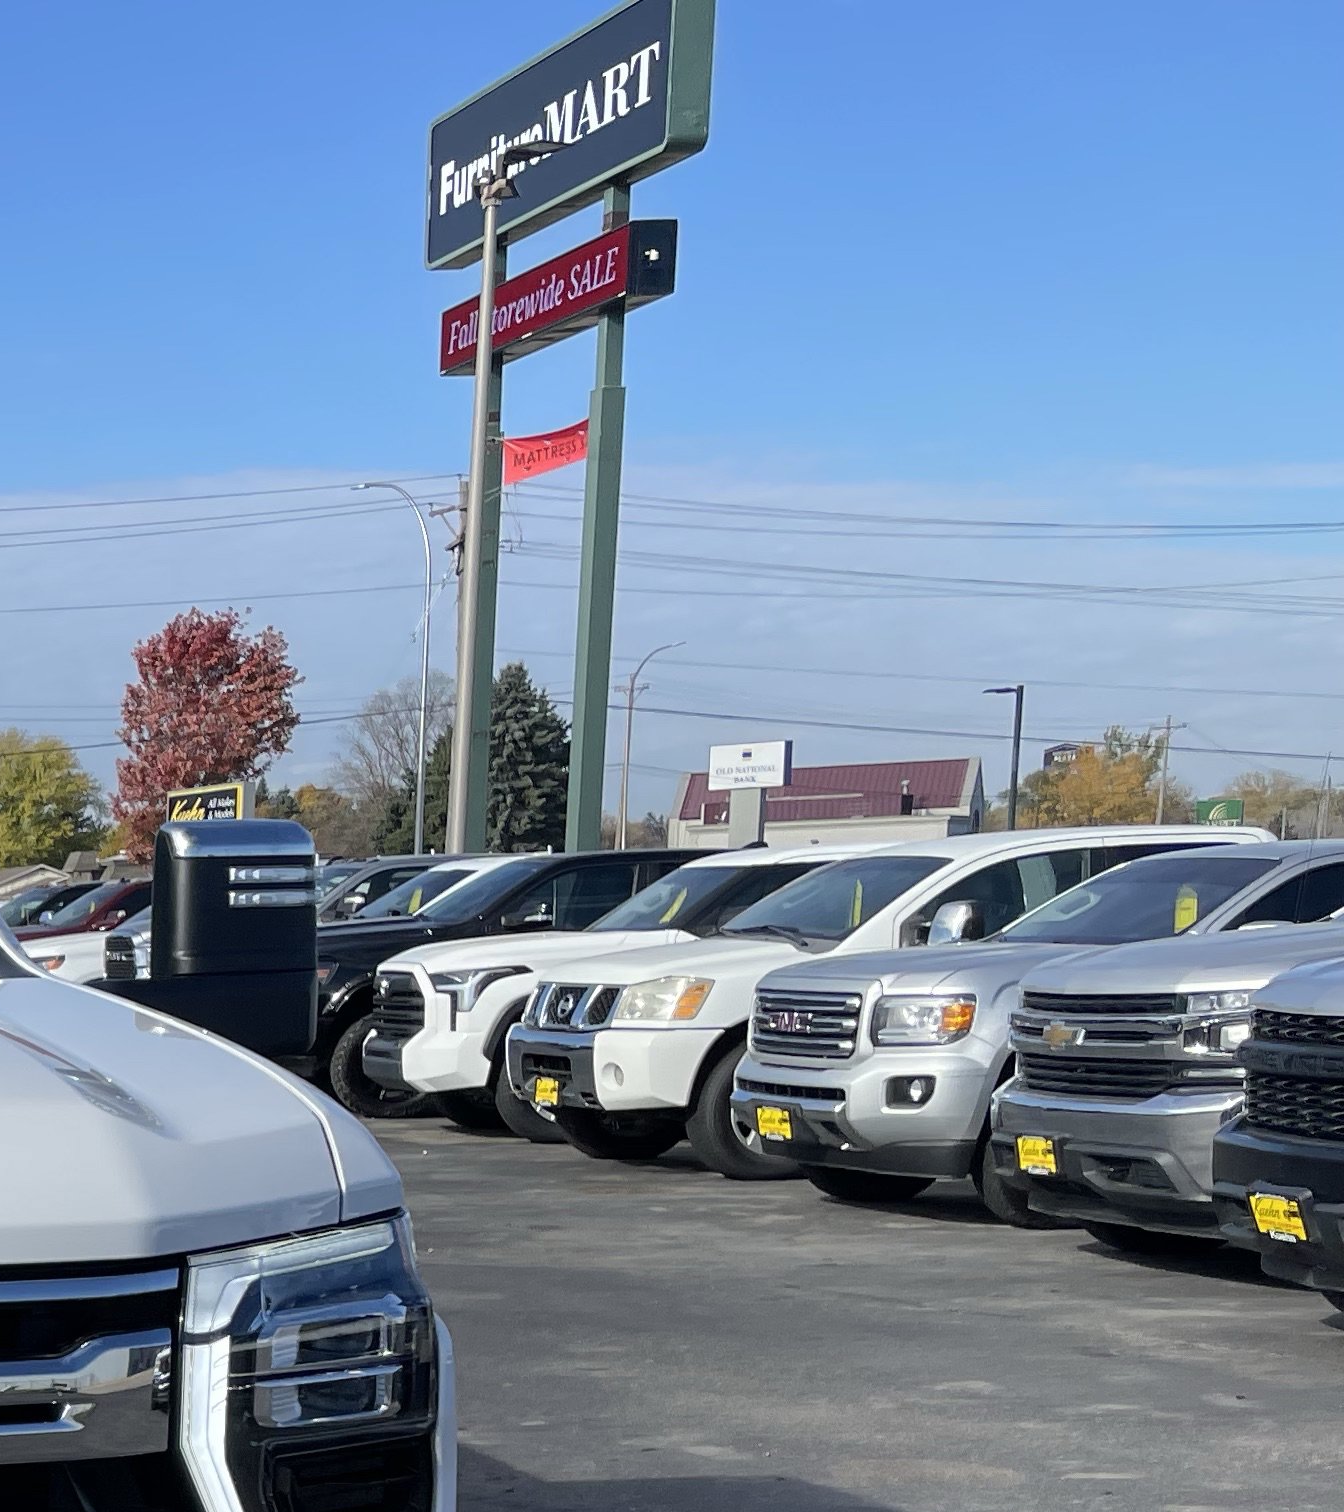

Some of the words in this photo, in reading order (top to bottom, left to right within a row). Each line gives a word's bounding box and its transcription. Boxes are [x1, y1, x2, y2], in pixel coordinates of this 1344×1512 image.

[489, 273, 565, 336] torewide
[567, 246, 619, 300] SALE
[513, 438, 577, 467] MATTRESS
[715, 766, 733, 775] OLD
[735, 764, 776, 775] NATIONAL
[733, 775, 756, 784] BANK
[768, 1011, 813, 1034] GMC
